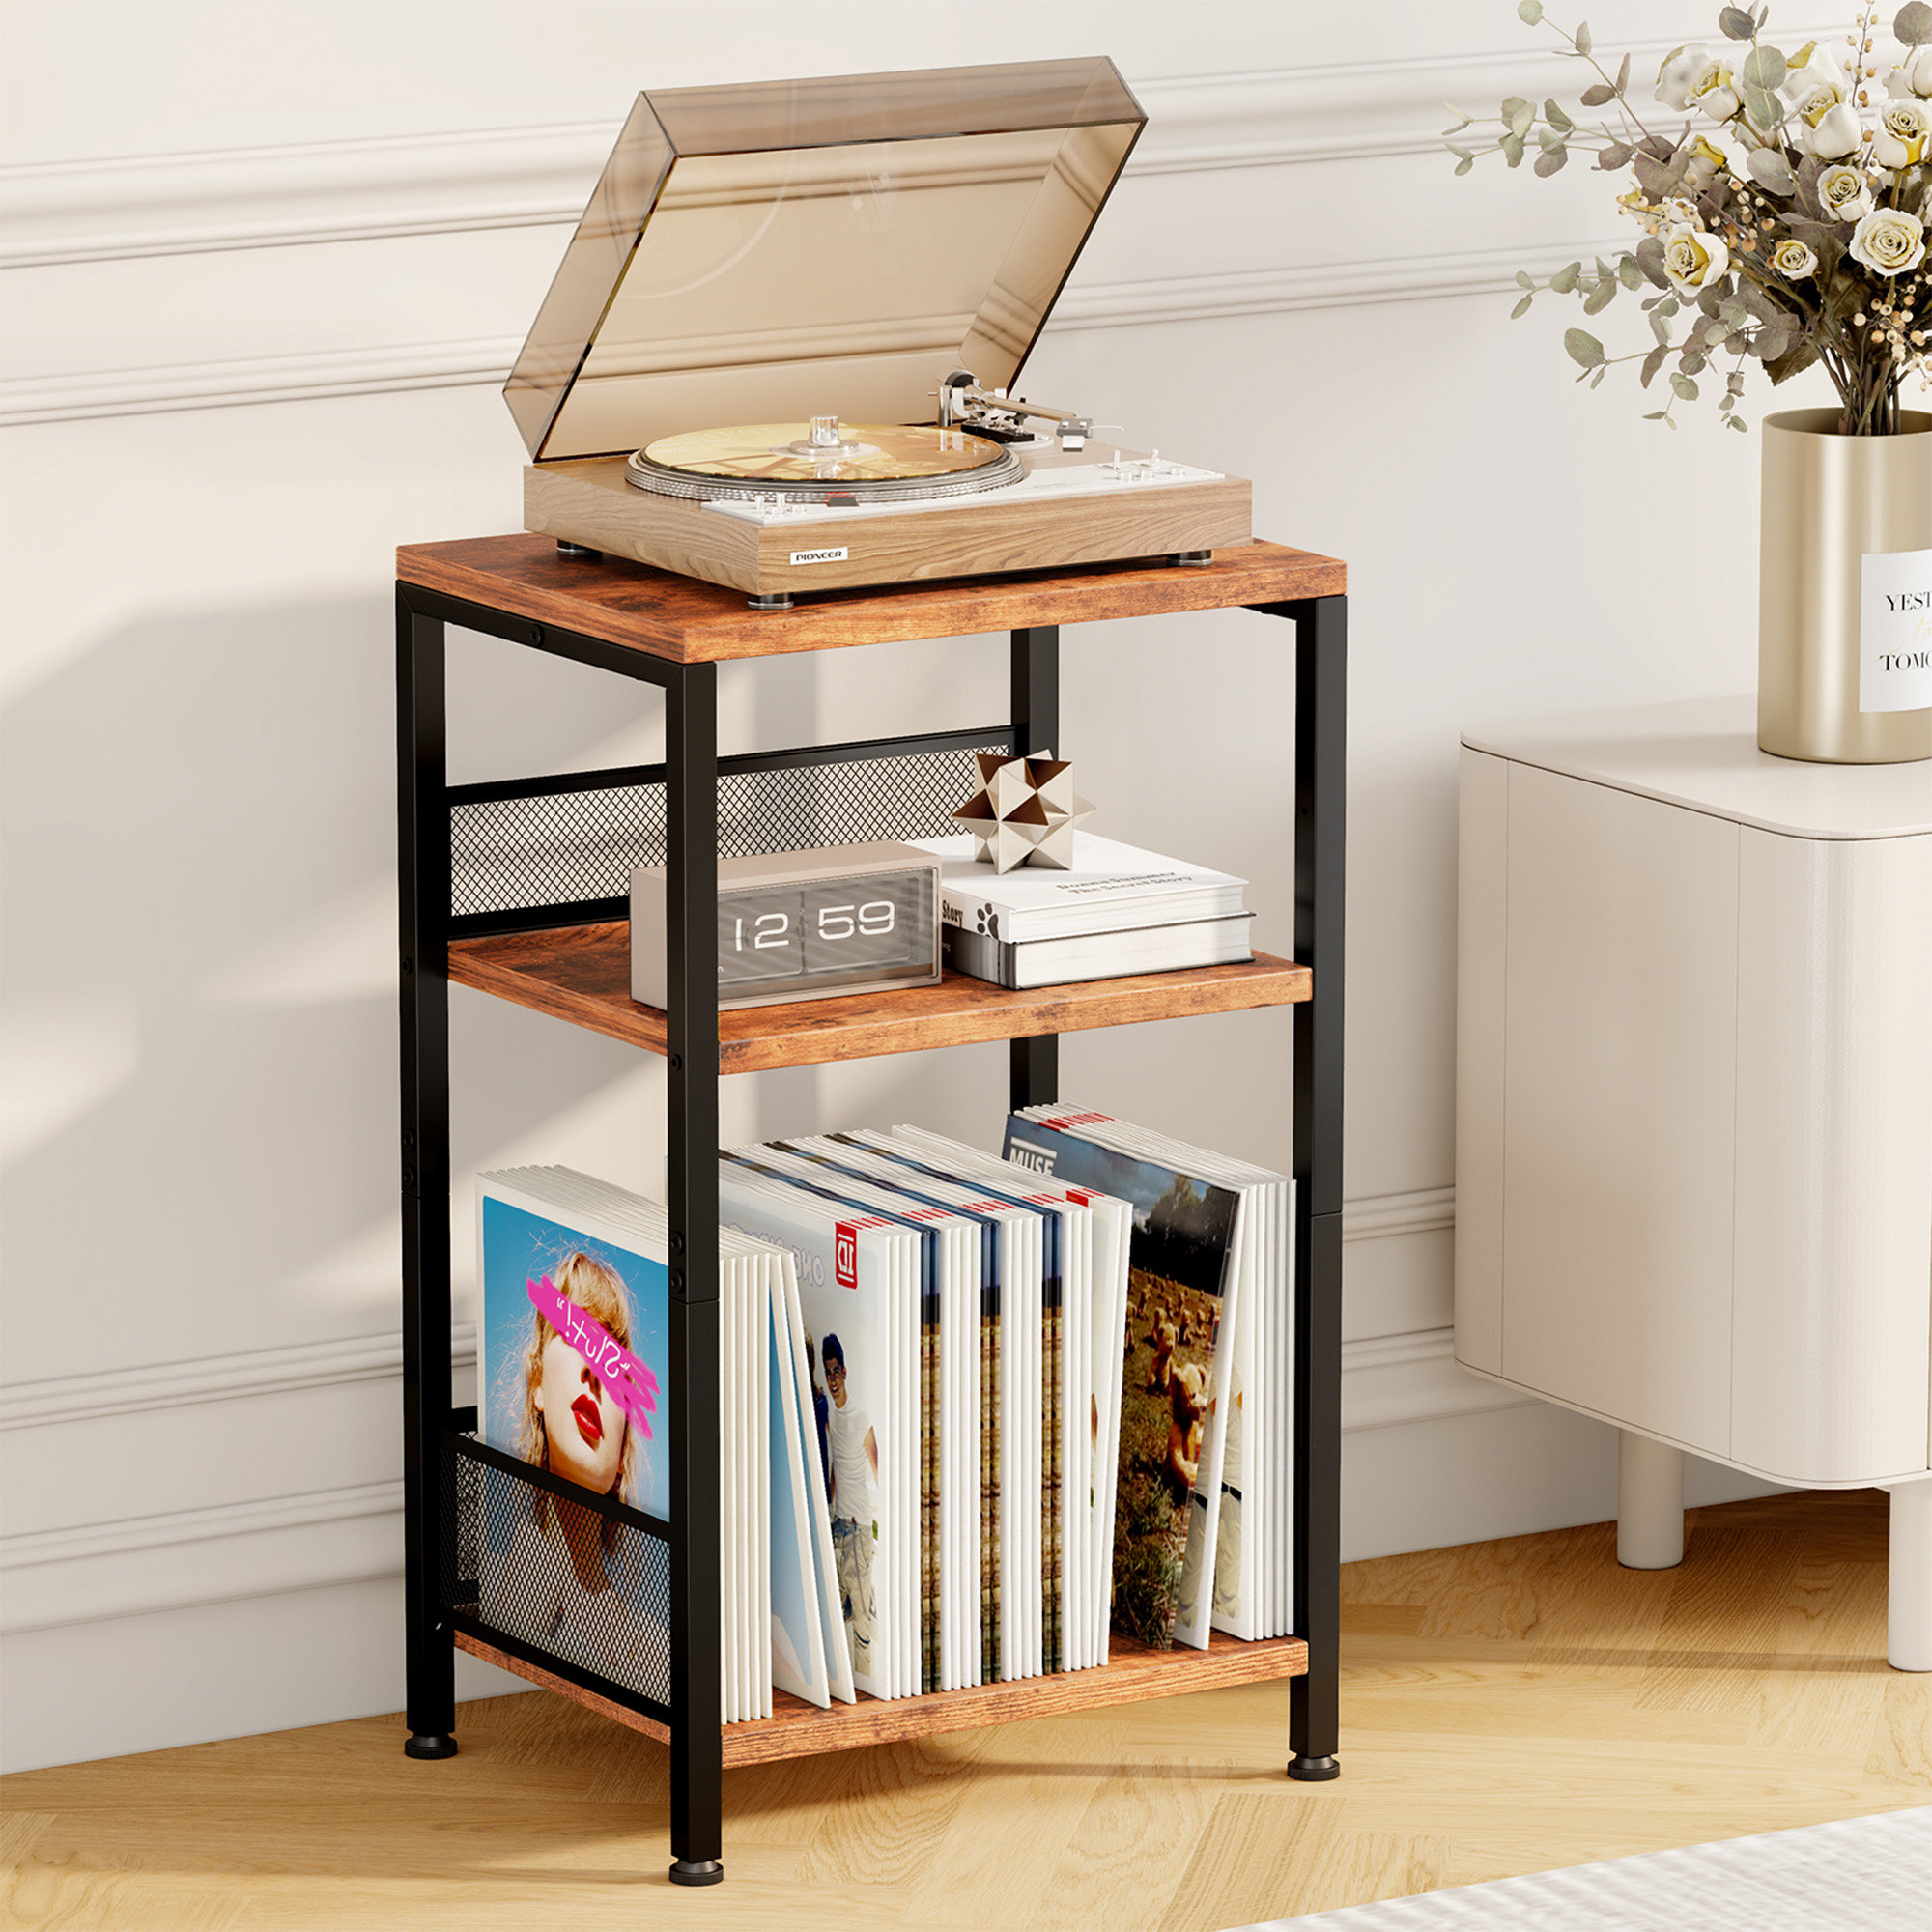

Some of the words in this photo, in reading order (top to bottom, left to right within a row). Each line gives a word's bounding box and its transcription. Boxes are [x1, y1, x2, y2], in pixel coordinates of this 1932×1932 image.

[796, 551, 842, 561] PIONEER
[1150, 875, 1193, 884] Story
[735, 913, 789, 952] 12
[818, 895, 895, 941] 59
[942, 899, 963, 928] Story
[1009, 1147, 1055, 1176] MUSE
